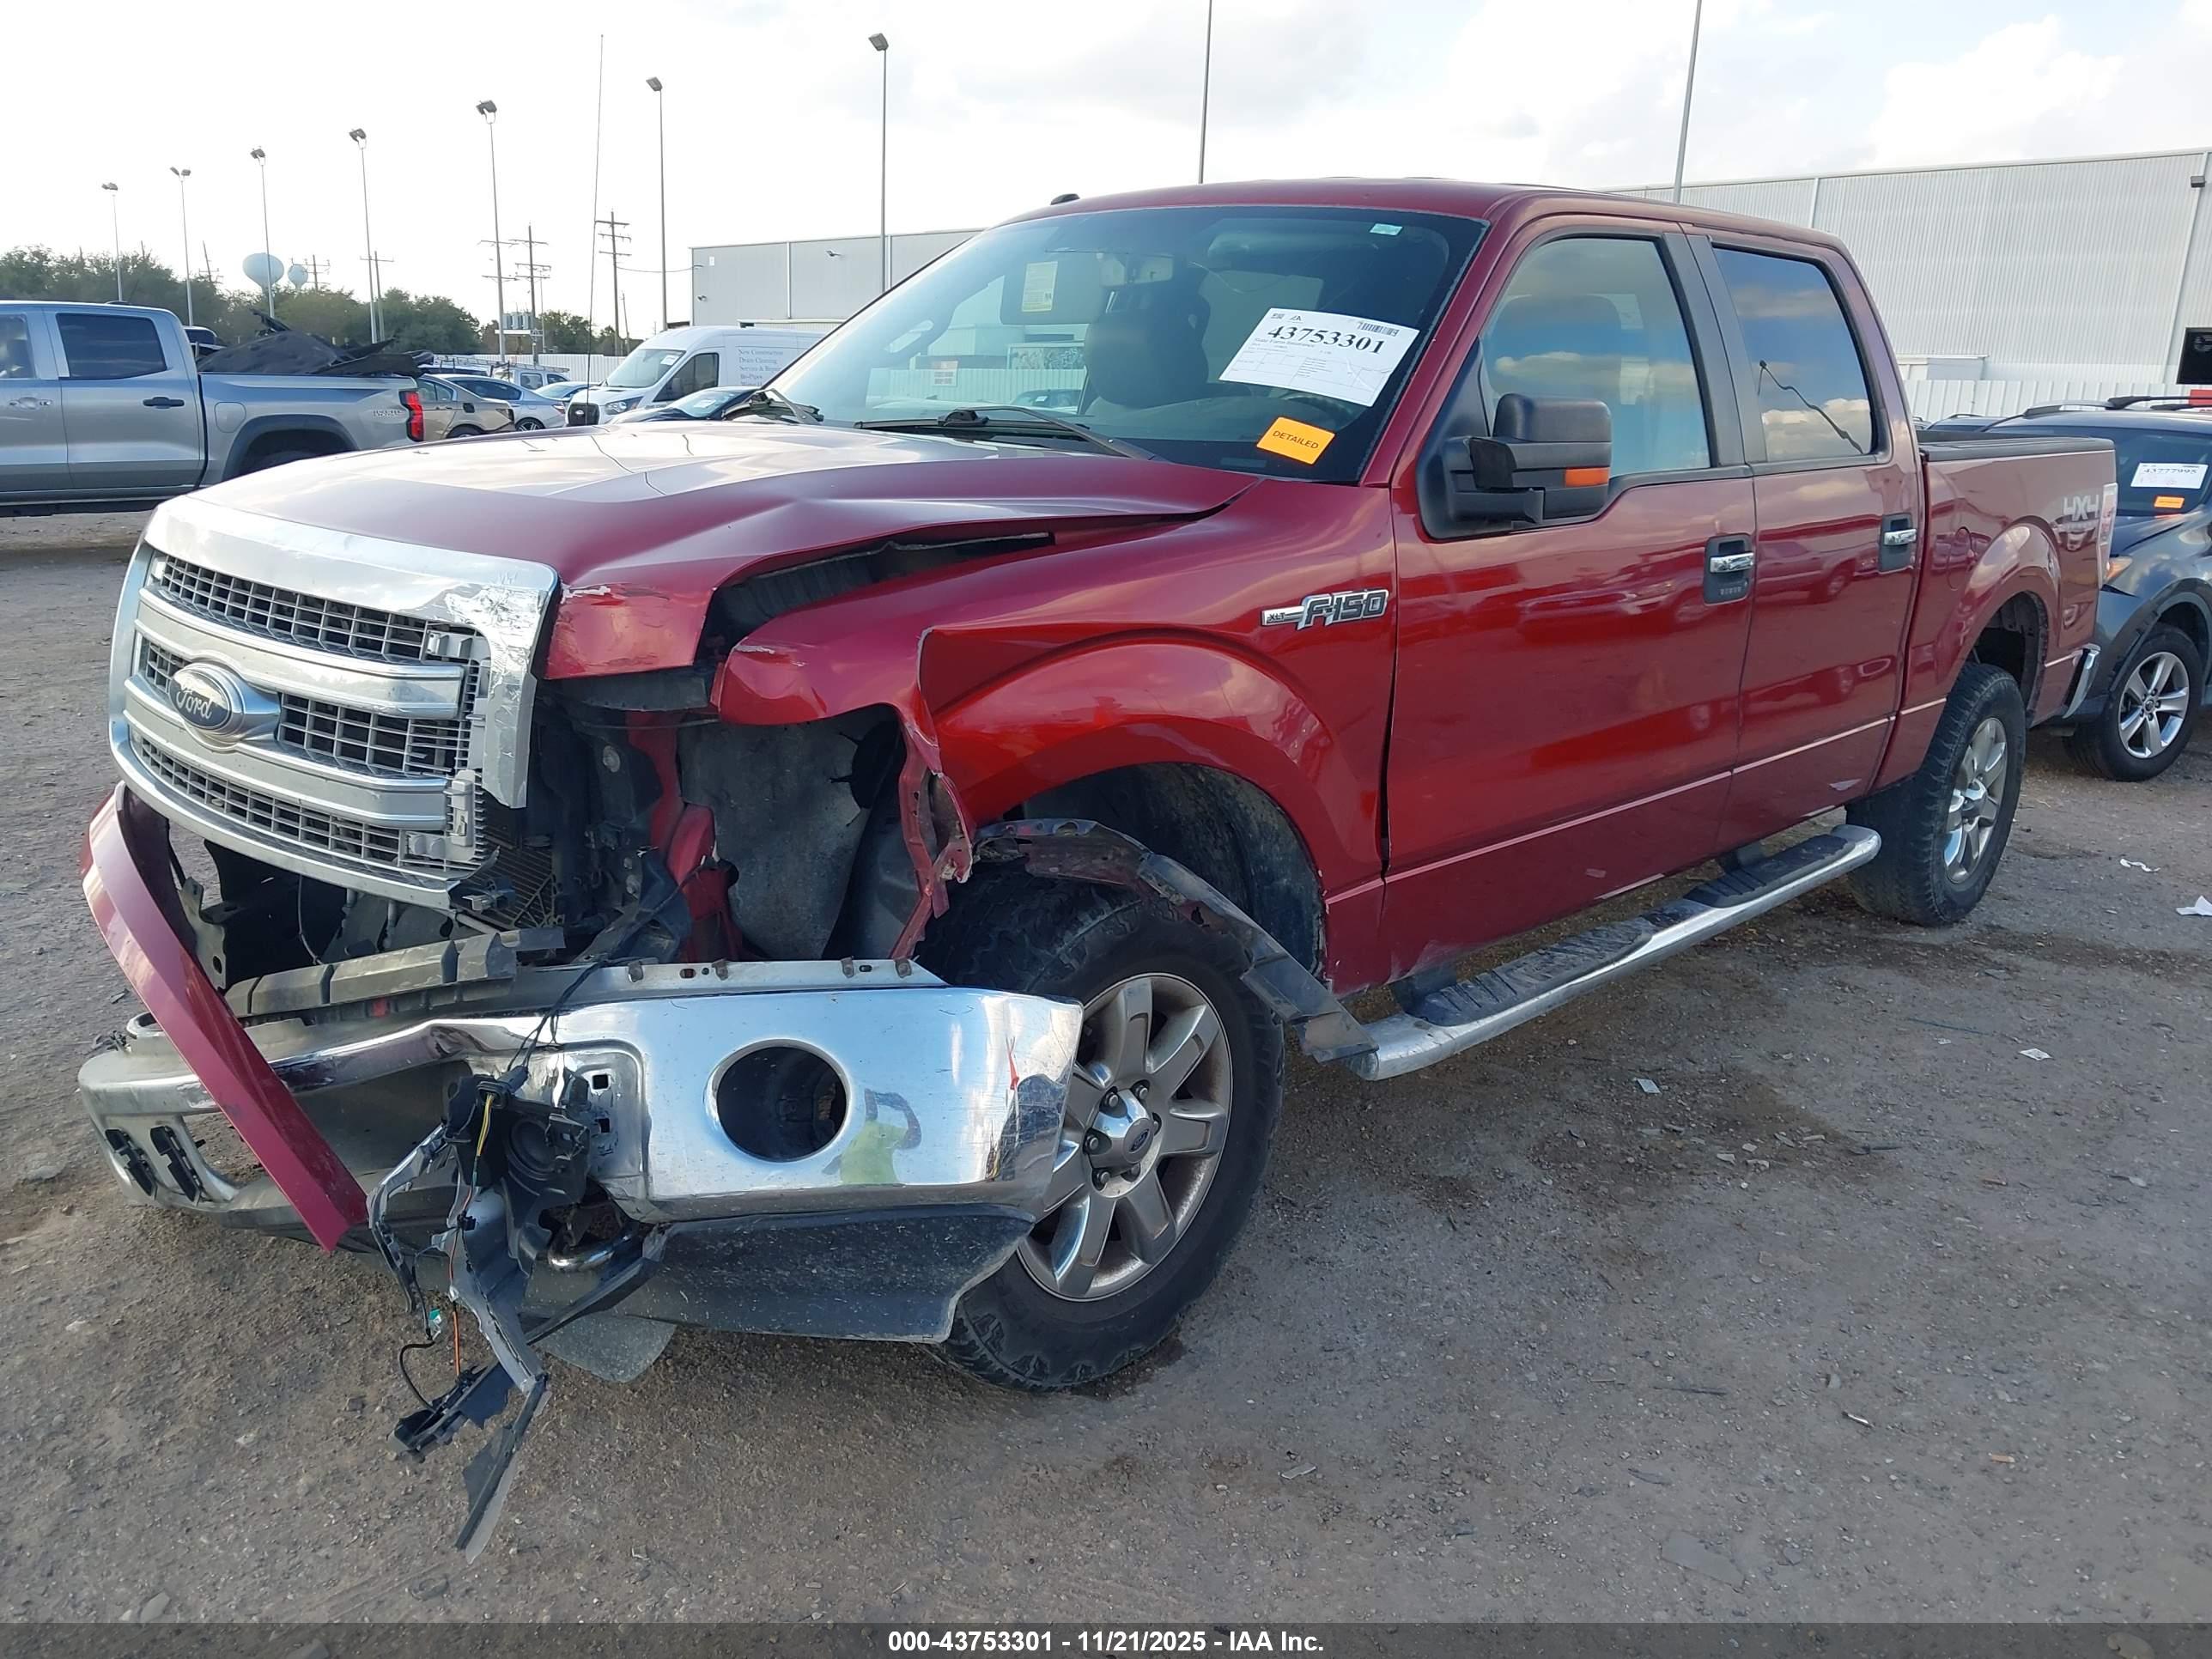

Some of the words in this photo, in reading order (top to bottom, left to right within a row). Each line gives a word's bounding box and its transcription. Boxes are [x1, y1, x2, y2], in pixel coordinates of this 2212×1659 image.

[1267, 325, 1386, 355] 43753301
[1272, 429, 1320, 450] DETAILED
[1267, 612, 1286, 623] XLT
[175, 684, 213, 720] Ford
